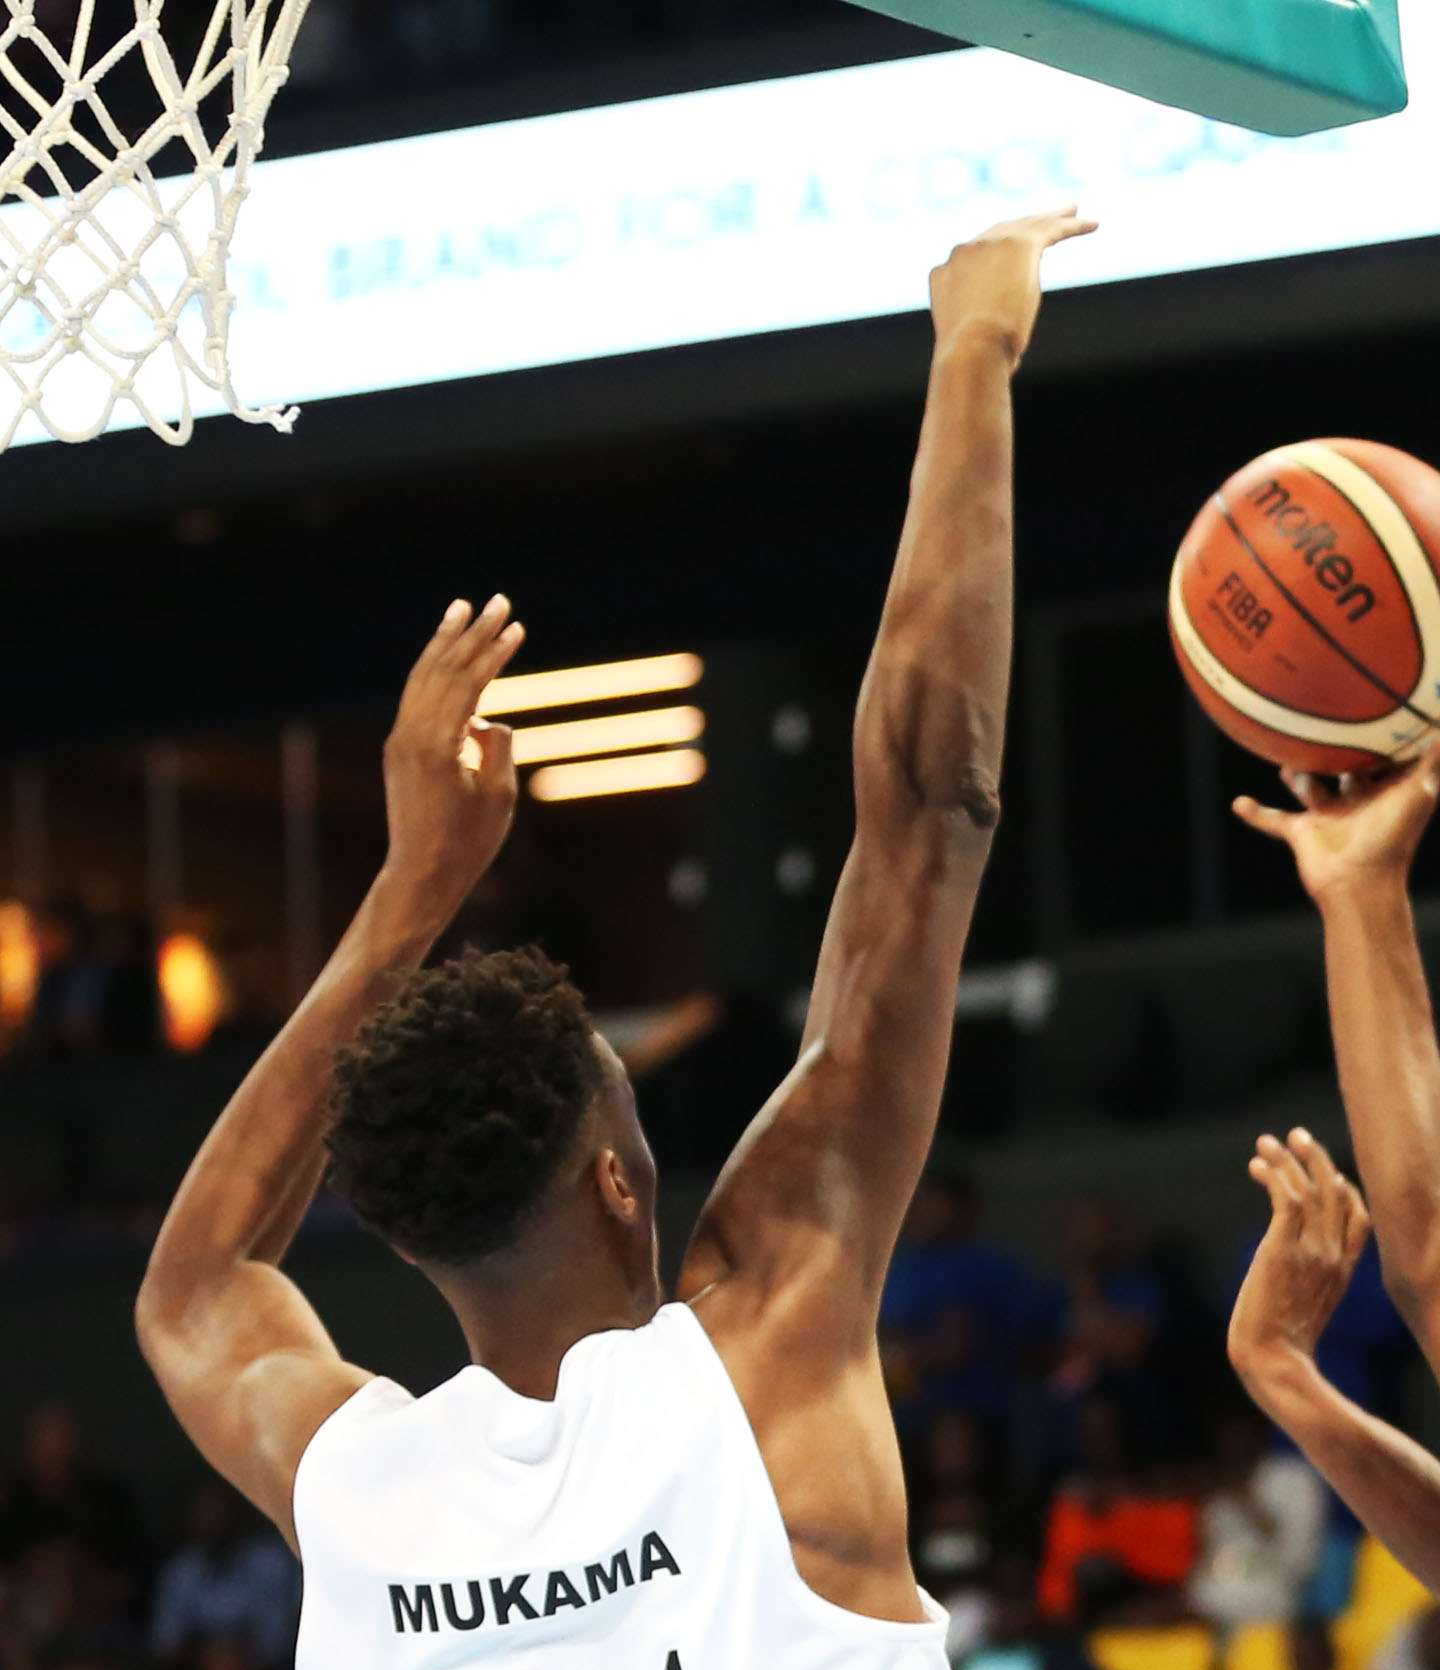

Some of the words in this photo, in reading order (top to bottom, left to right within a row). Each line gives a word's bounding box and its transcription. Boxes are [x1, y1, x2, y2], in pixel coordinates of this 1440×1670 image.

[1245, 477, 1376, 623] molten
[1215, 570, 1274, 639] FIBA
[387, 1530, 683, 1634] MUKAMA
